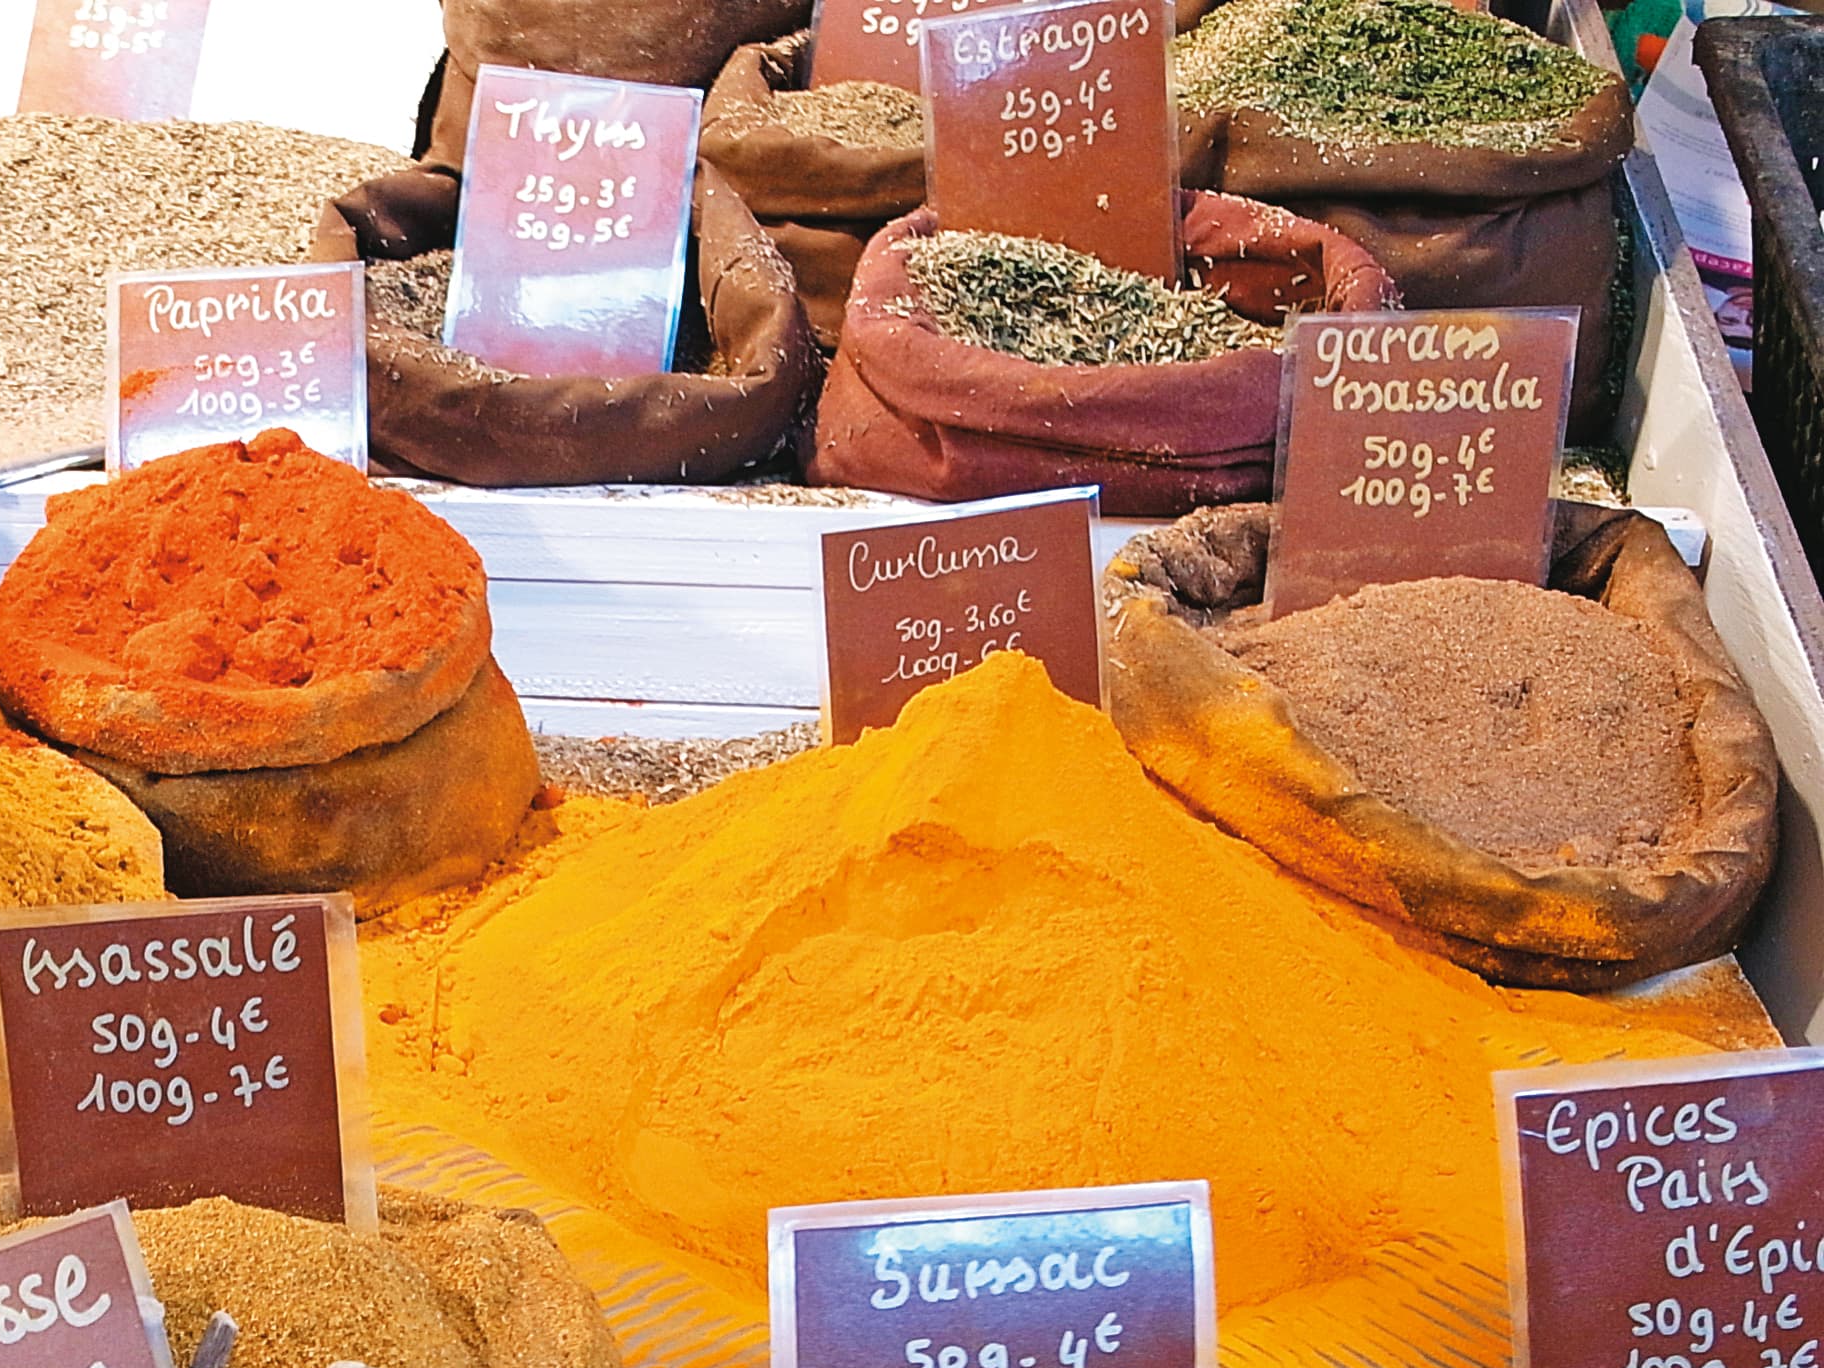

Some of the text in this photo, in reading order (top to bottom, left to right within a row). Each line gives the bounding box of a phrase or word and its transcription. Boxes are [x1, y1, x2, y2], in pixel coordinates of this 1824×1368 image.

[952, 7, 1150, 71] Estragon
[494, 97, 647, 161] Thym
[143, 278, 336, 338] Paprika
[1312, 322, 1501, 388] garam
[1332, 361, 1544, 414] massala
[1544, 1096, 1738, 1172] Epices
[1616, 1155, 1770, 1213] Pain
